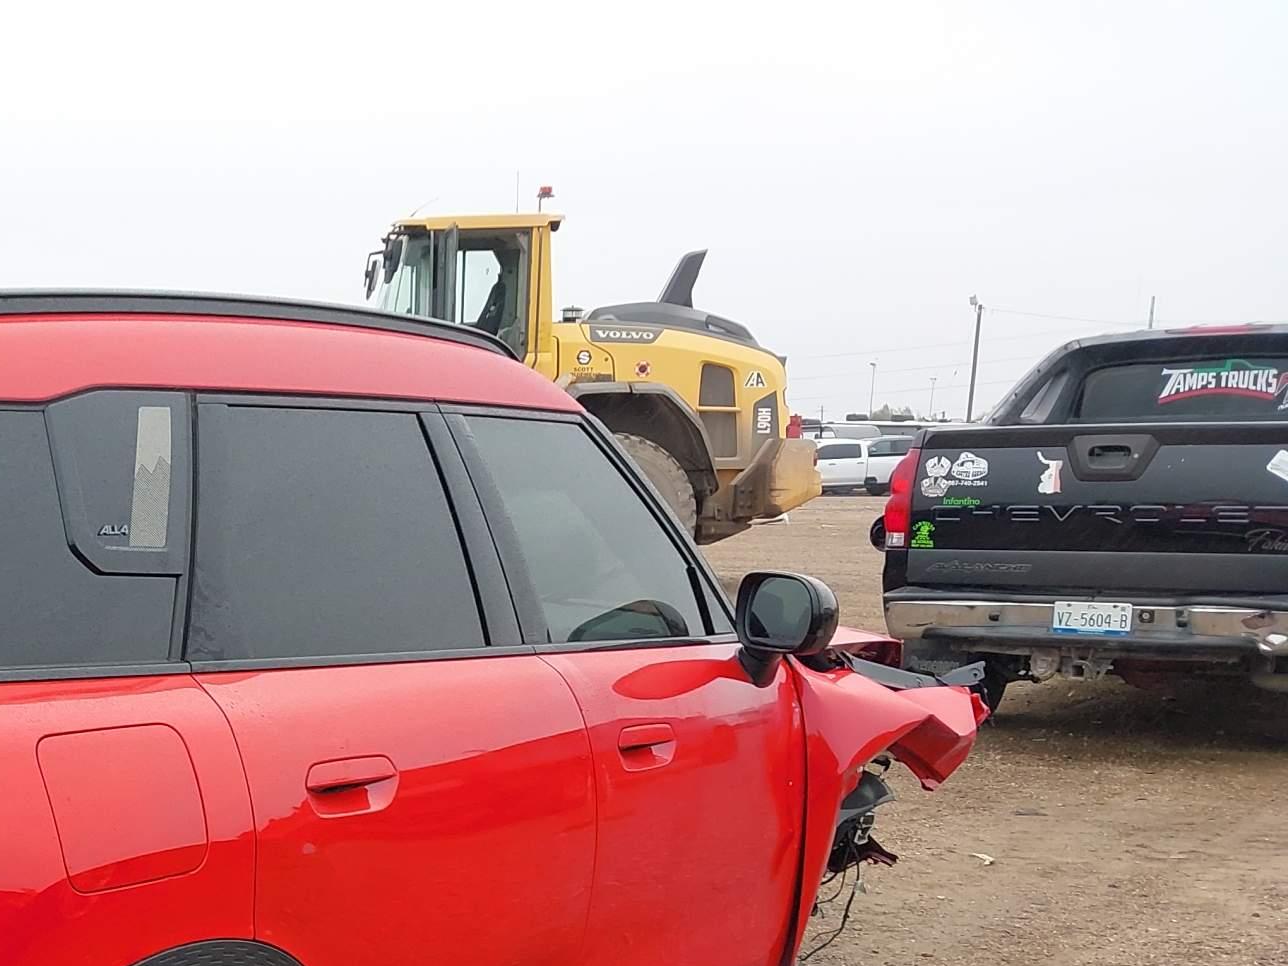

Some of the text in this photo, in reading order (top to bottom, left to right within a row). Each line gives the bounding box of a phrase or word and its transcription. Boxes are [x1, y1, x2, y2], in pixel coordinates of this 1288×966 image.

[596, 329, 654, 340] VOLVO
[1158, 368, 1278, 399] TAMPS TRUCKS
[757, 407, 772, 434] L90H
[943, 496, 981, 506] Infantino
[1056, 611, 1128, 629] VZ-5604-B
